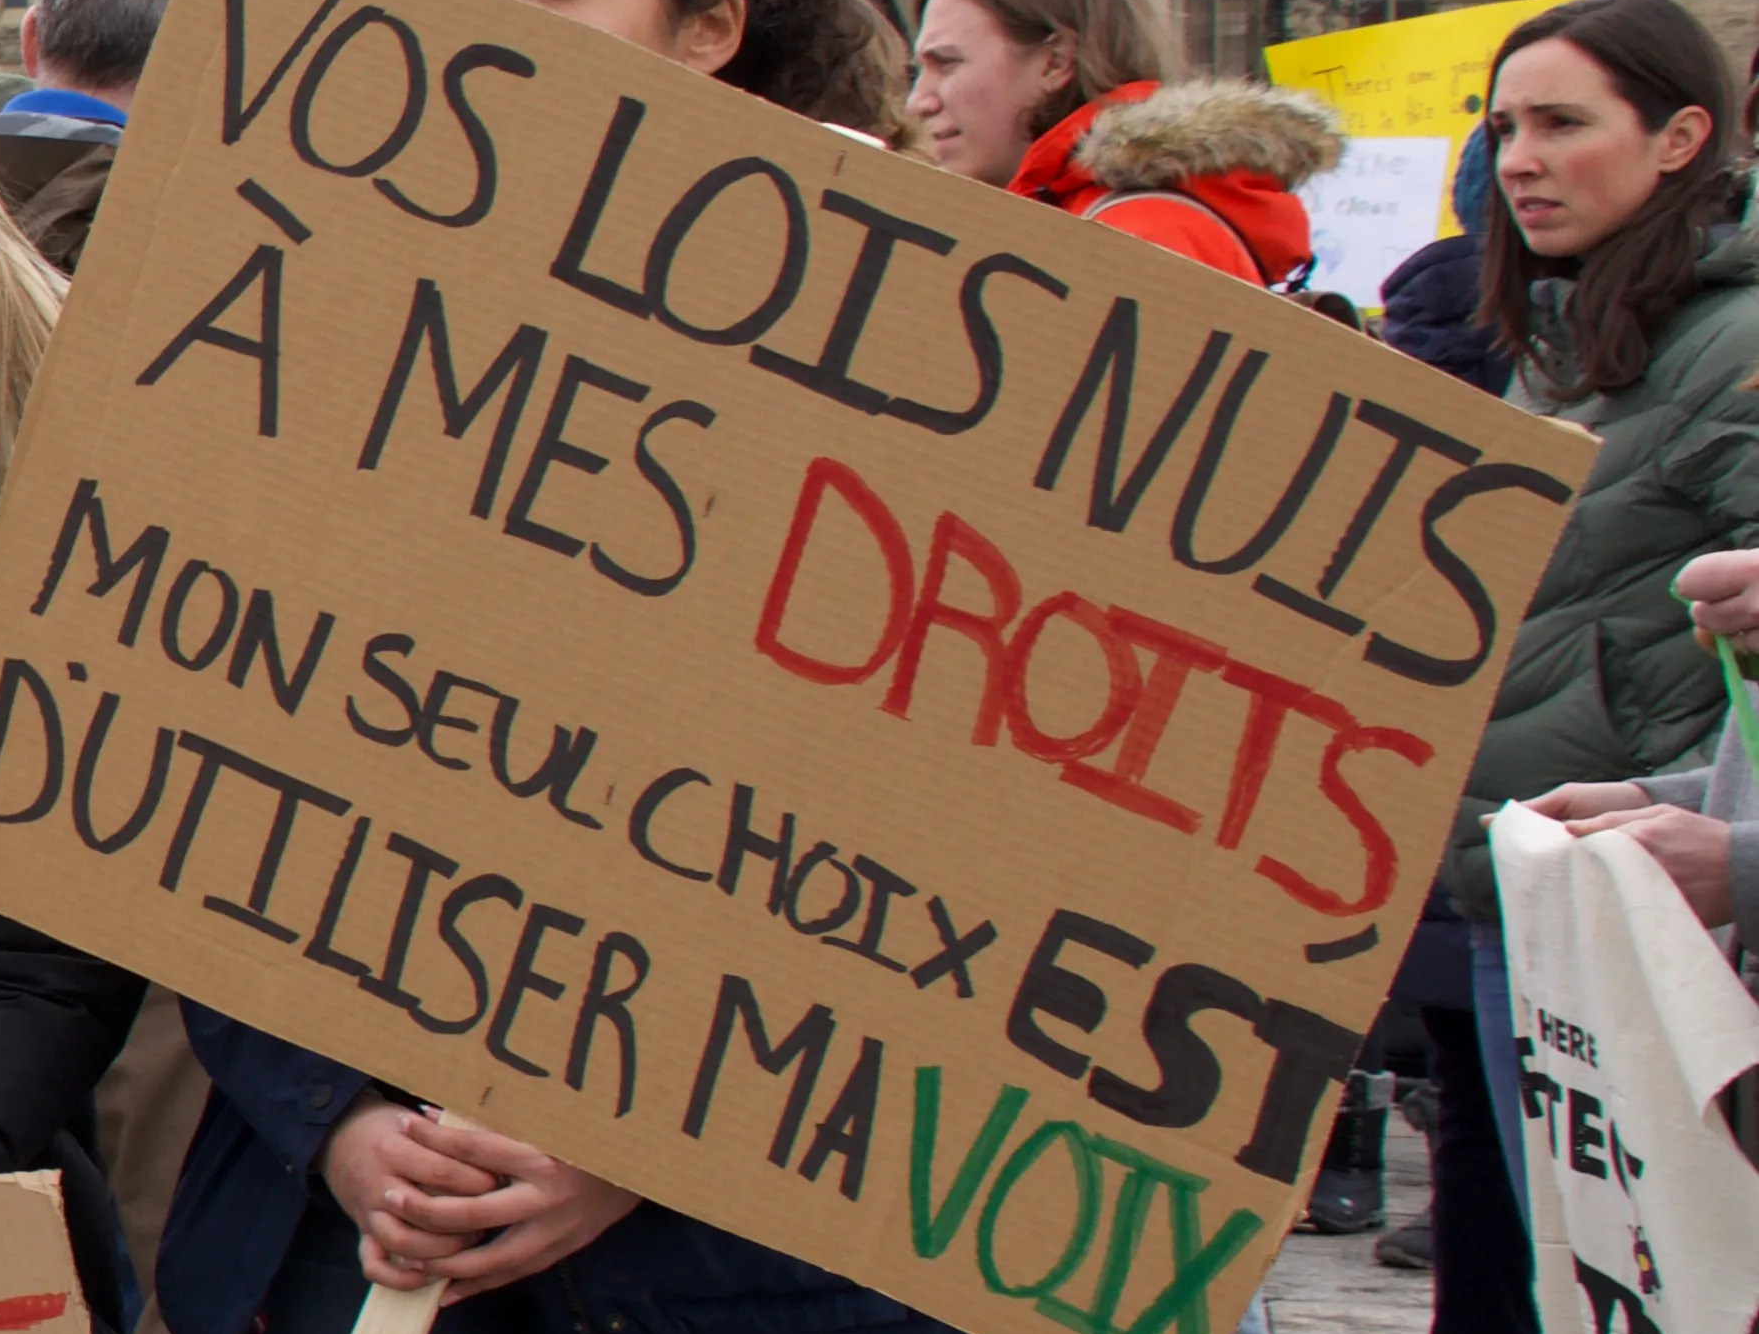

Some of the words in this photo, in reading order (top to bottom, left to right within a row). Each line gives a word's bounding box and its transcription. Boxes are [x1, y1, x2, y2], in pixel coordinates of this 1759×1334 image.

[136, 181, 313, 439] À
[357, 277, 717, 599] MES
[550, 94, 1069, 439] LOIS
[31, 478, 334, 733] MON
[345, 632, 608, 831] SEUL
[628, 765, 998, 1001] CHOIX
[1007, 907, 1367, 1185] EST
[681, 973, 884, 1201] MA
